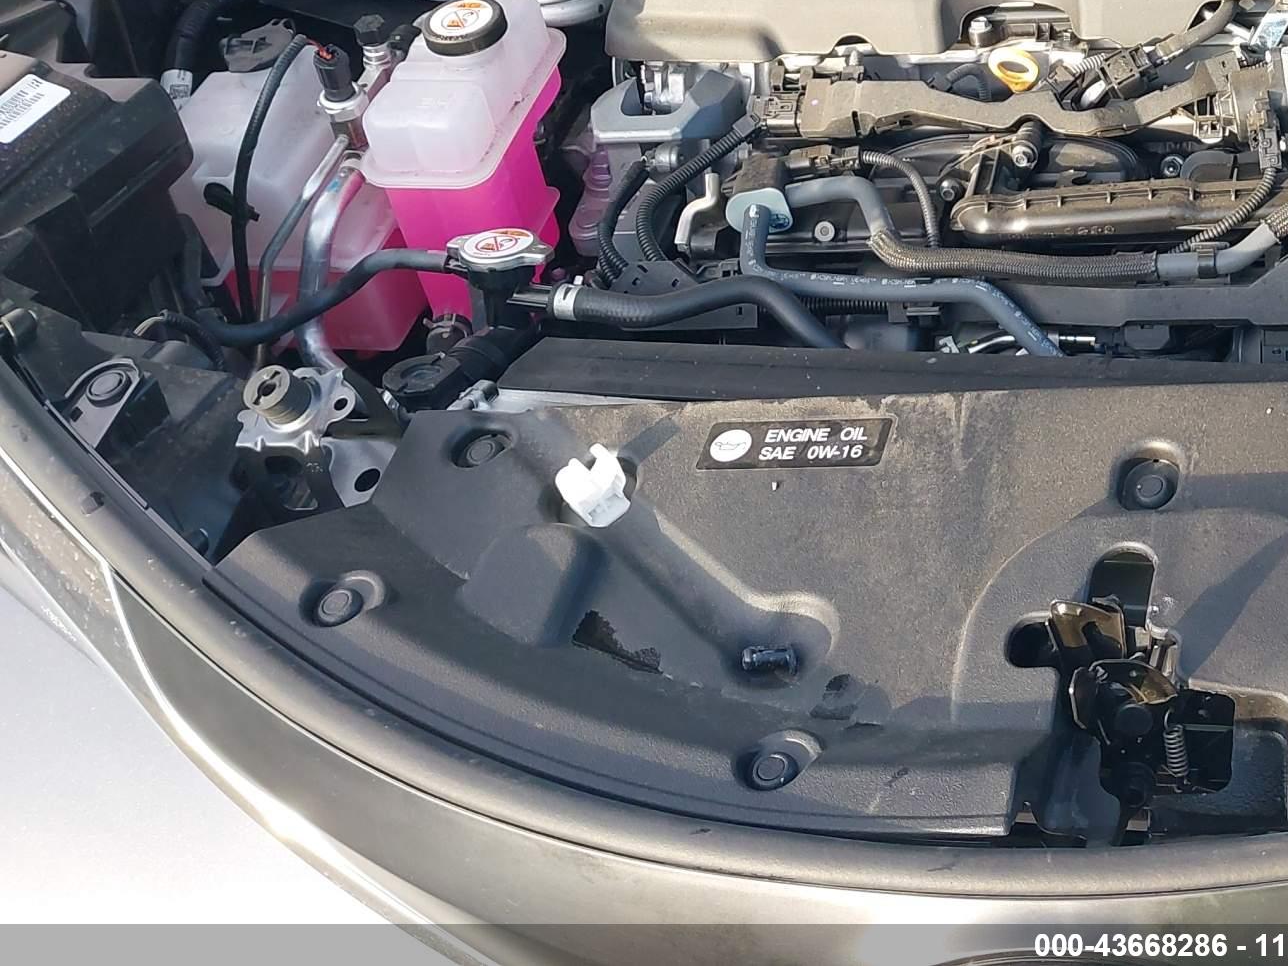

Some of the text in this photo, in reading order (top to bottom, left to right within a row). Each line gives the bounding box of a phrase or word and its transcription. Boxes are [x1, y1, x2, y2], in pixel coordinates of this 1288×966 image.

[764, 426, 867, 443] ENGINE OIL
[758, 445, 863, 461] SAE 0W-16
